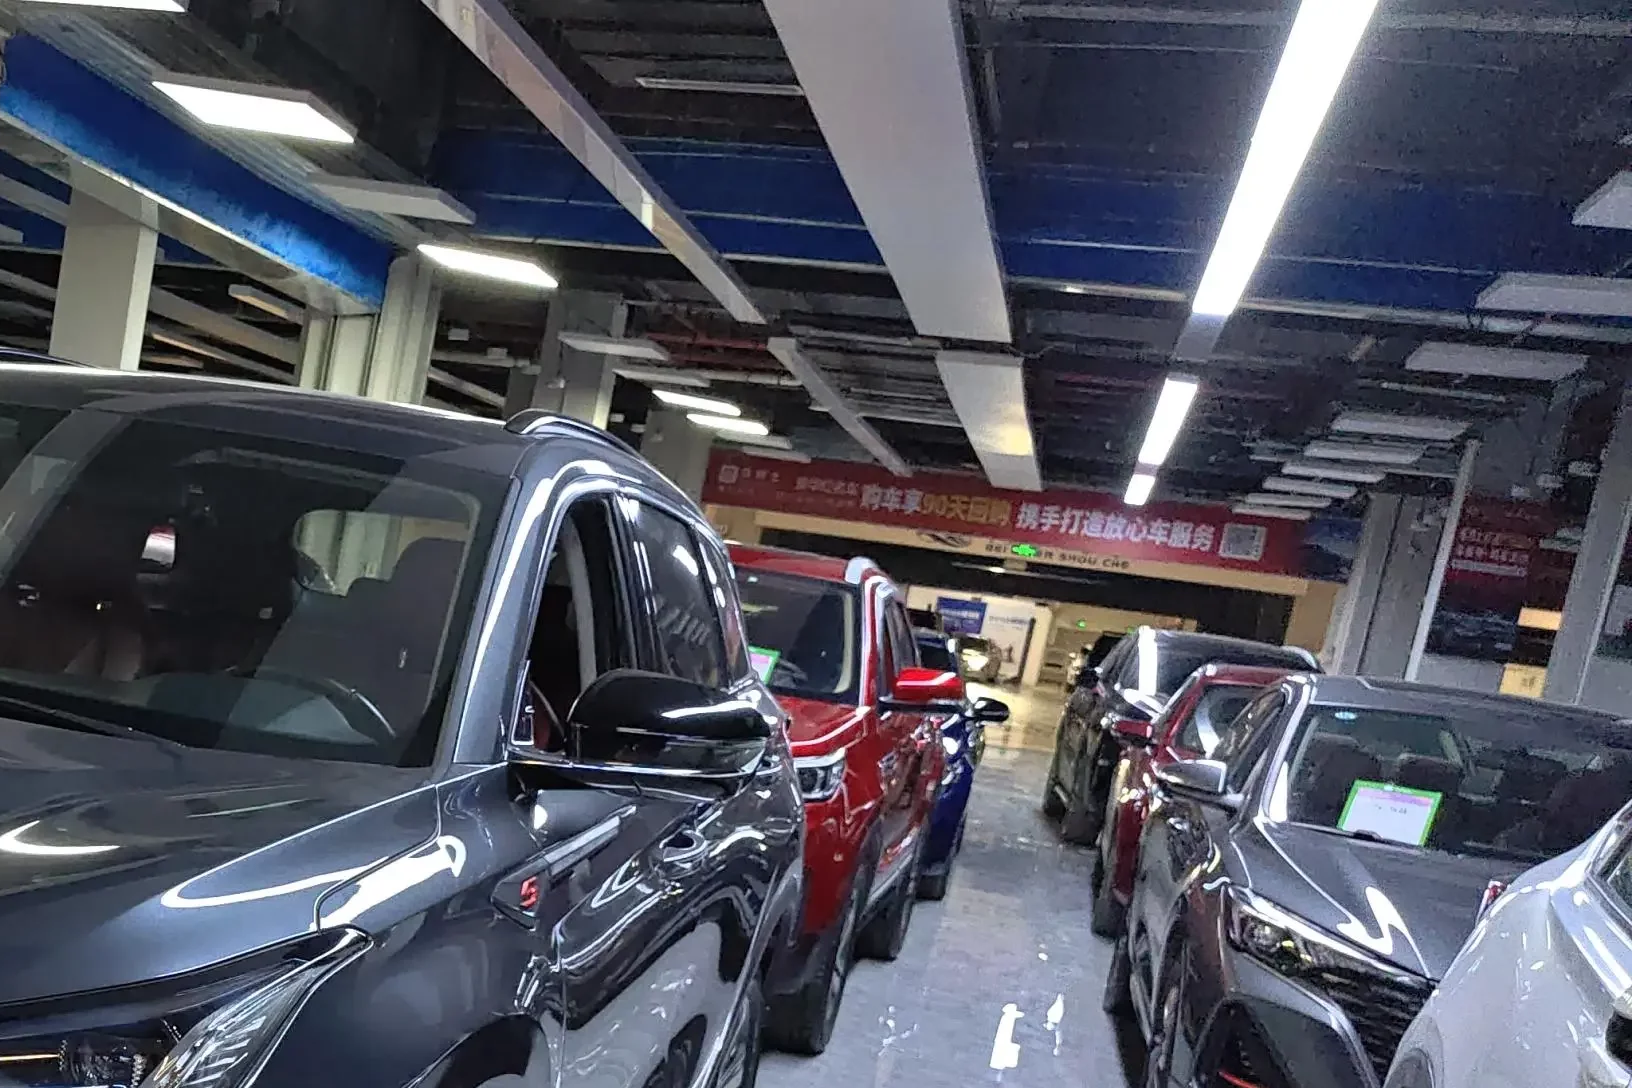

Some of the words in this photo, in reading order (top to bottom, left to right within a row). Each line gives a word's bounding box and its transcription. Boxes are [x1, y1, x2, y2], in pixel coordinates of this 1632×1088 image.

[1016, 502, 1215, 551] 携手打造放心车服务
